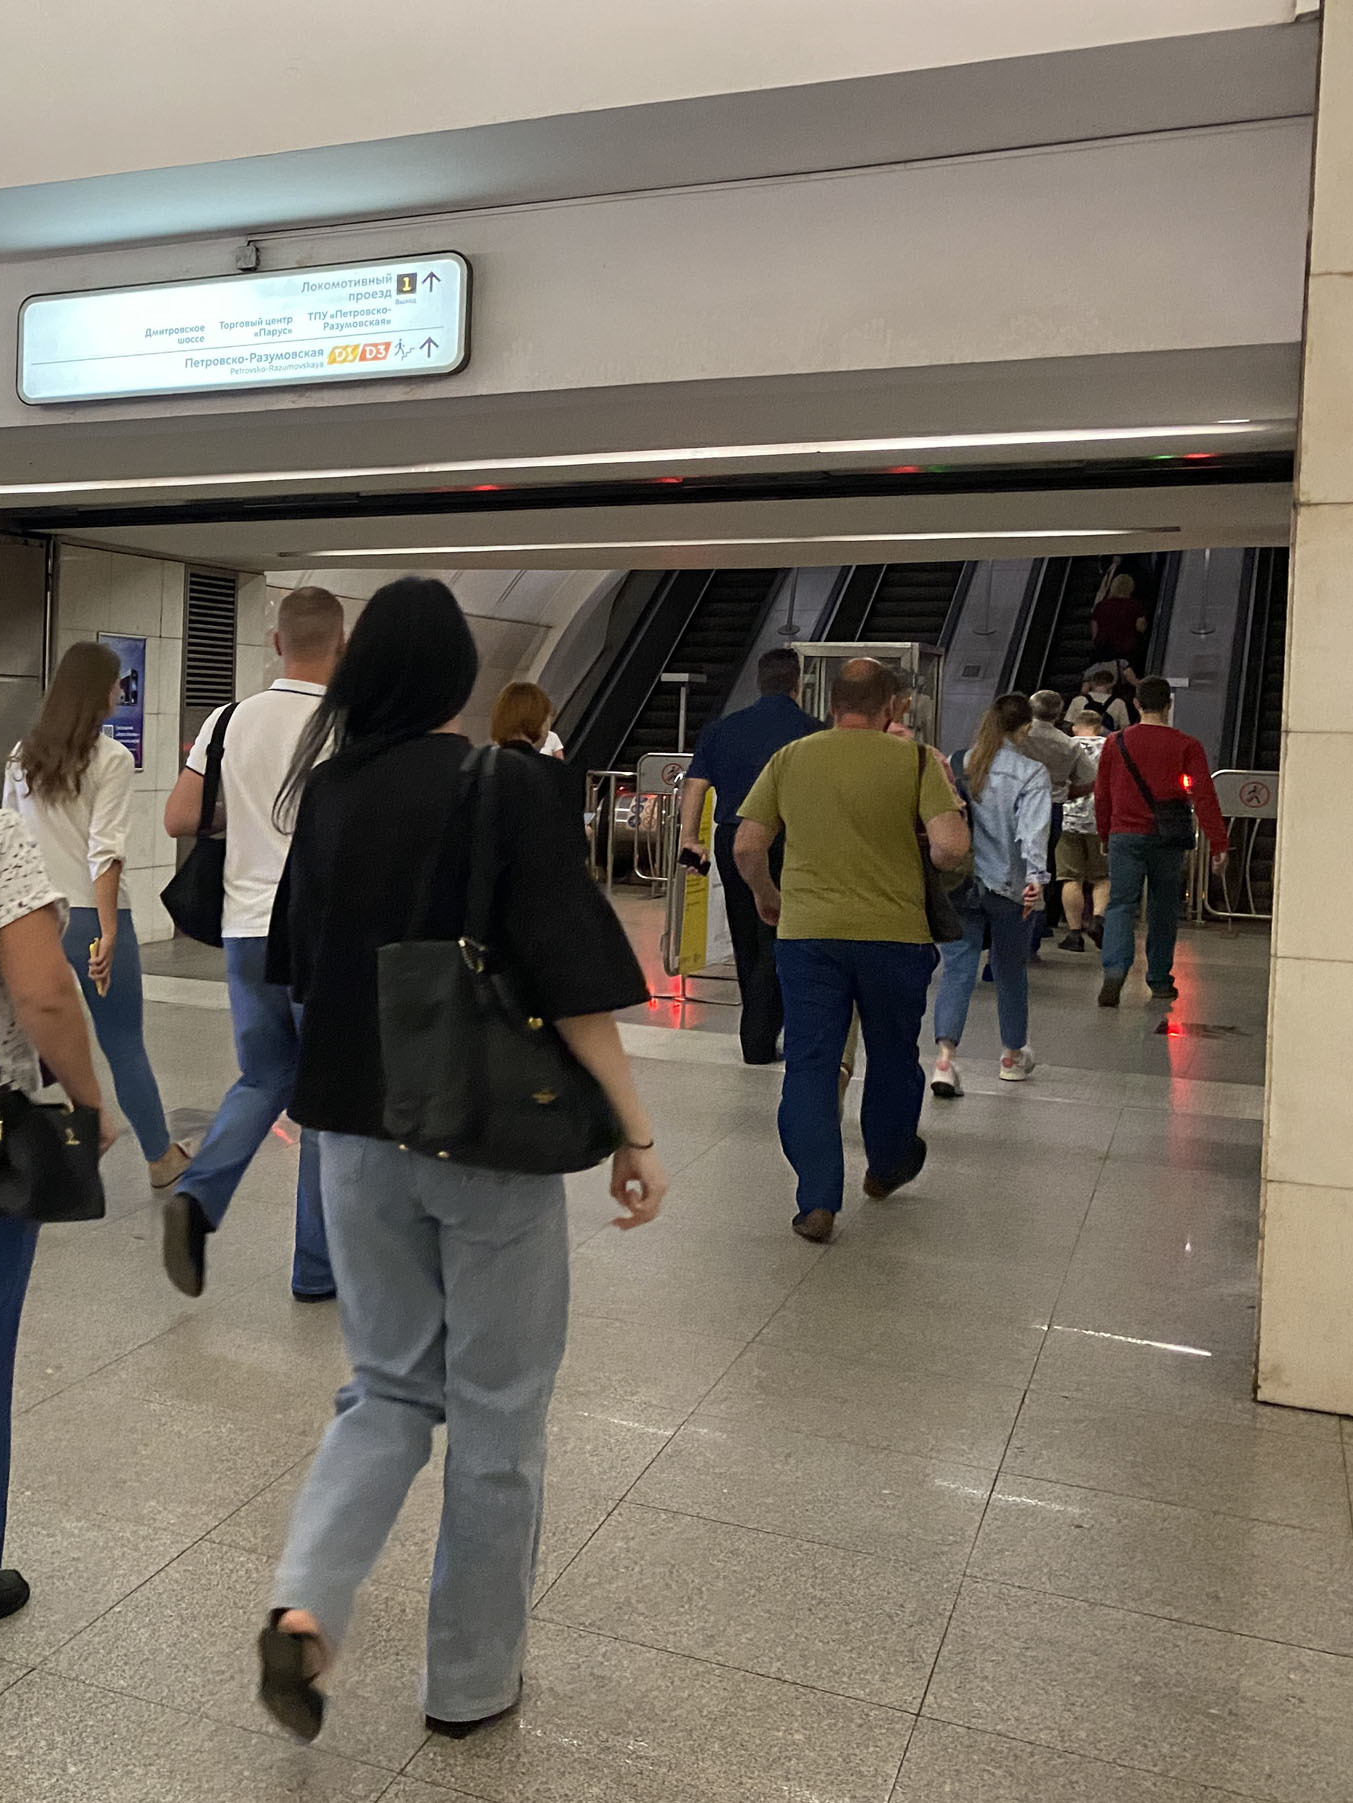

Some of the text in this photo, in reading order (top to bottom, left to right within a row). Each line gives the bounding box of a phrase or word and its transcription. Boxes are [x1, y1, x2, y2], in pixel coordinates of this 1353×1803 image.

[301, 273, 392, 292] Локомотивный
[402, 276, 411, 291] 1
[348, 289, 392, 303] проезд
[219, 316, 293, 330] Торговый центр
[308, 311, 328, 321] ТПУ
[145, 325, 205, 338] Дмитровское
[177, 335, 205, 344] шоссе
[185, 348, 324, 369] Петровско-Разумовская
[365, 345, 386, 359] D3
